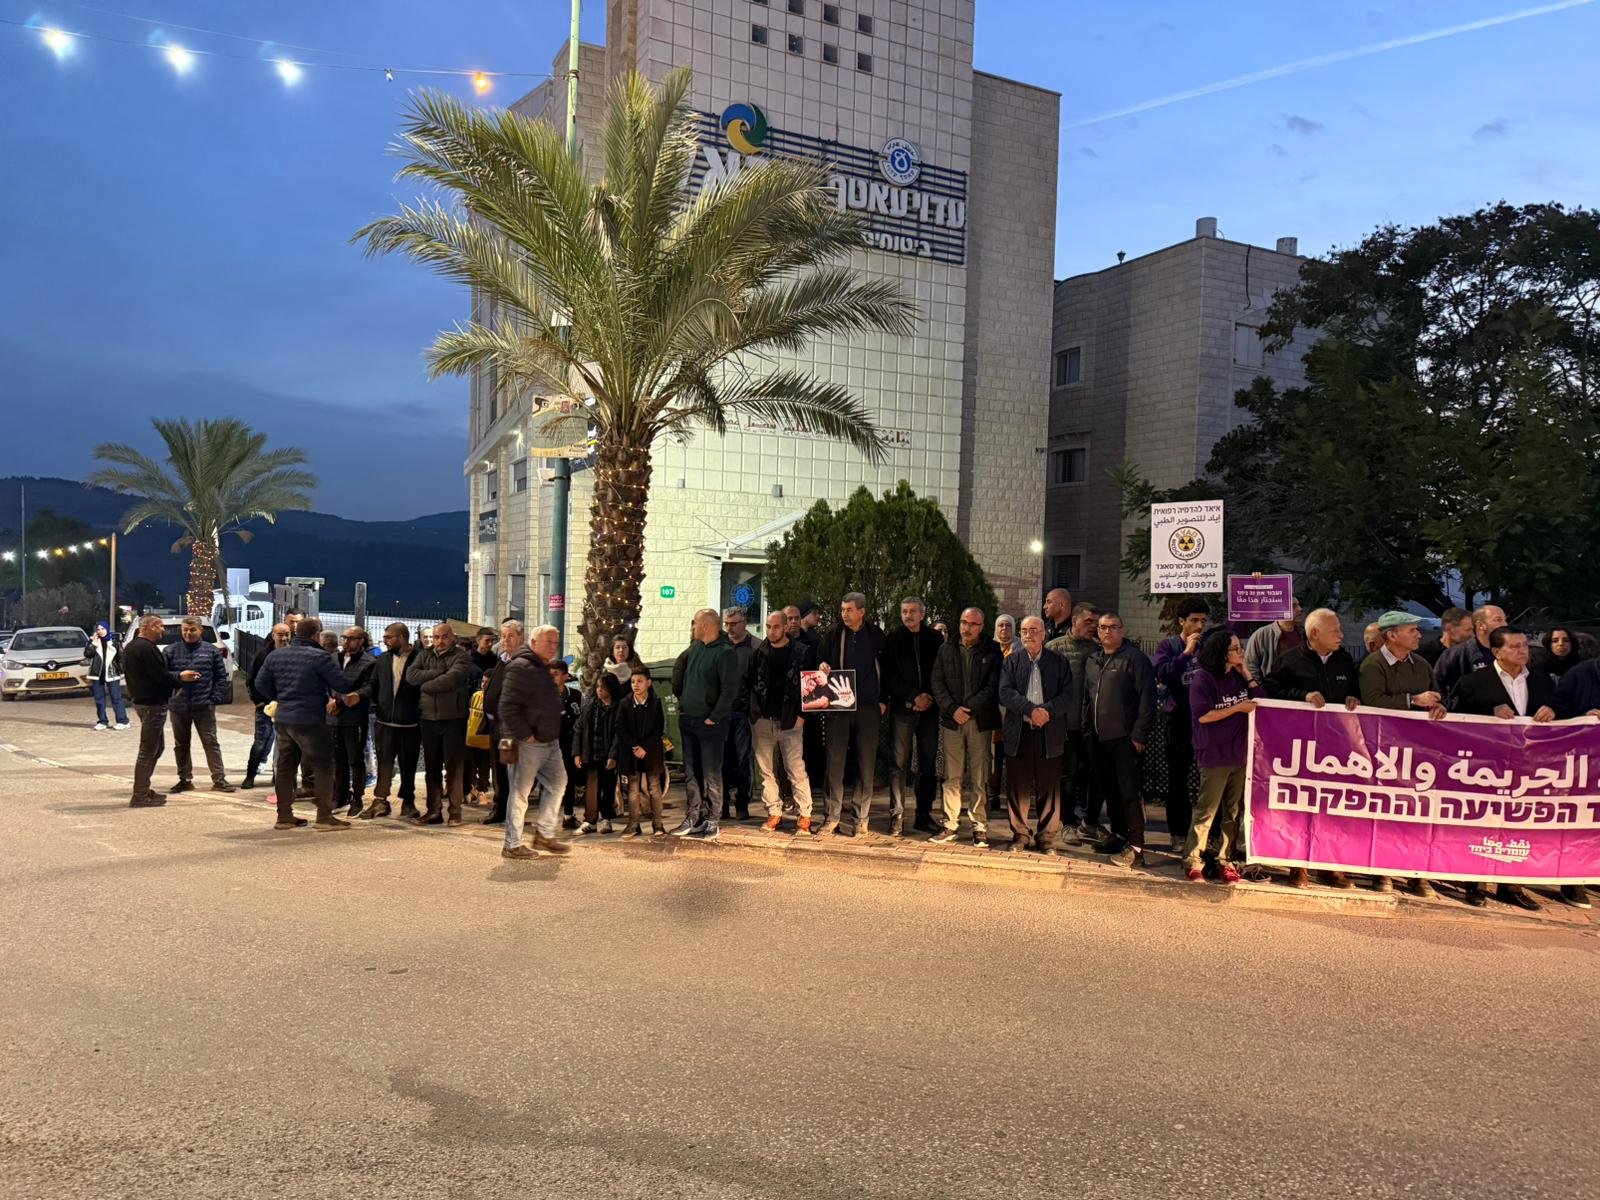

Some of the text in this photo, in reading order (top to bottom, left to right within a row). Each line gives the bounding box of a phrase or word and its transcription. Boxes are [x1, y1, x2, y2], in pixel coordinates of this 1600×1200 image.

[1154, 581, 1218, 589] 054-9009976
[1271, 738, 1590, 799] الجريمة والاهمال
[1276, 780, 1432, 818] וההפקרה
[1440, 796, 1578, 825] הפשיעה
[1468, 845, 1530, 856] עומדים ביחד
